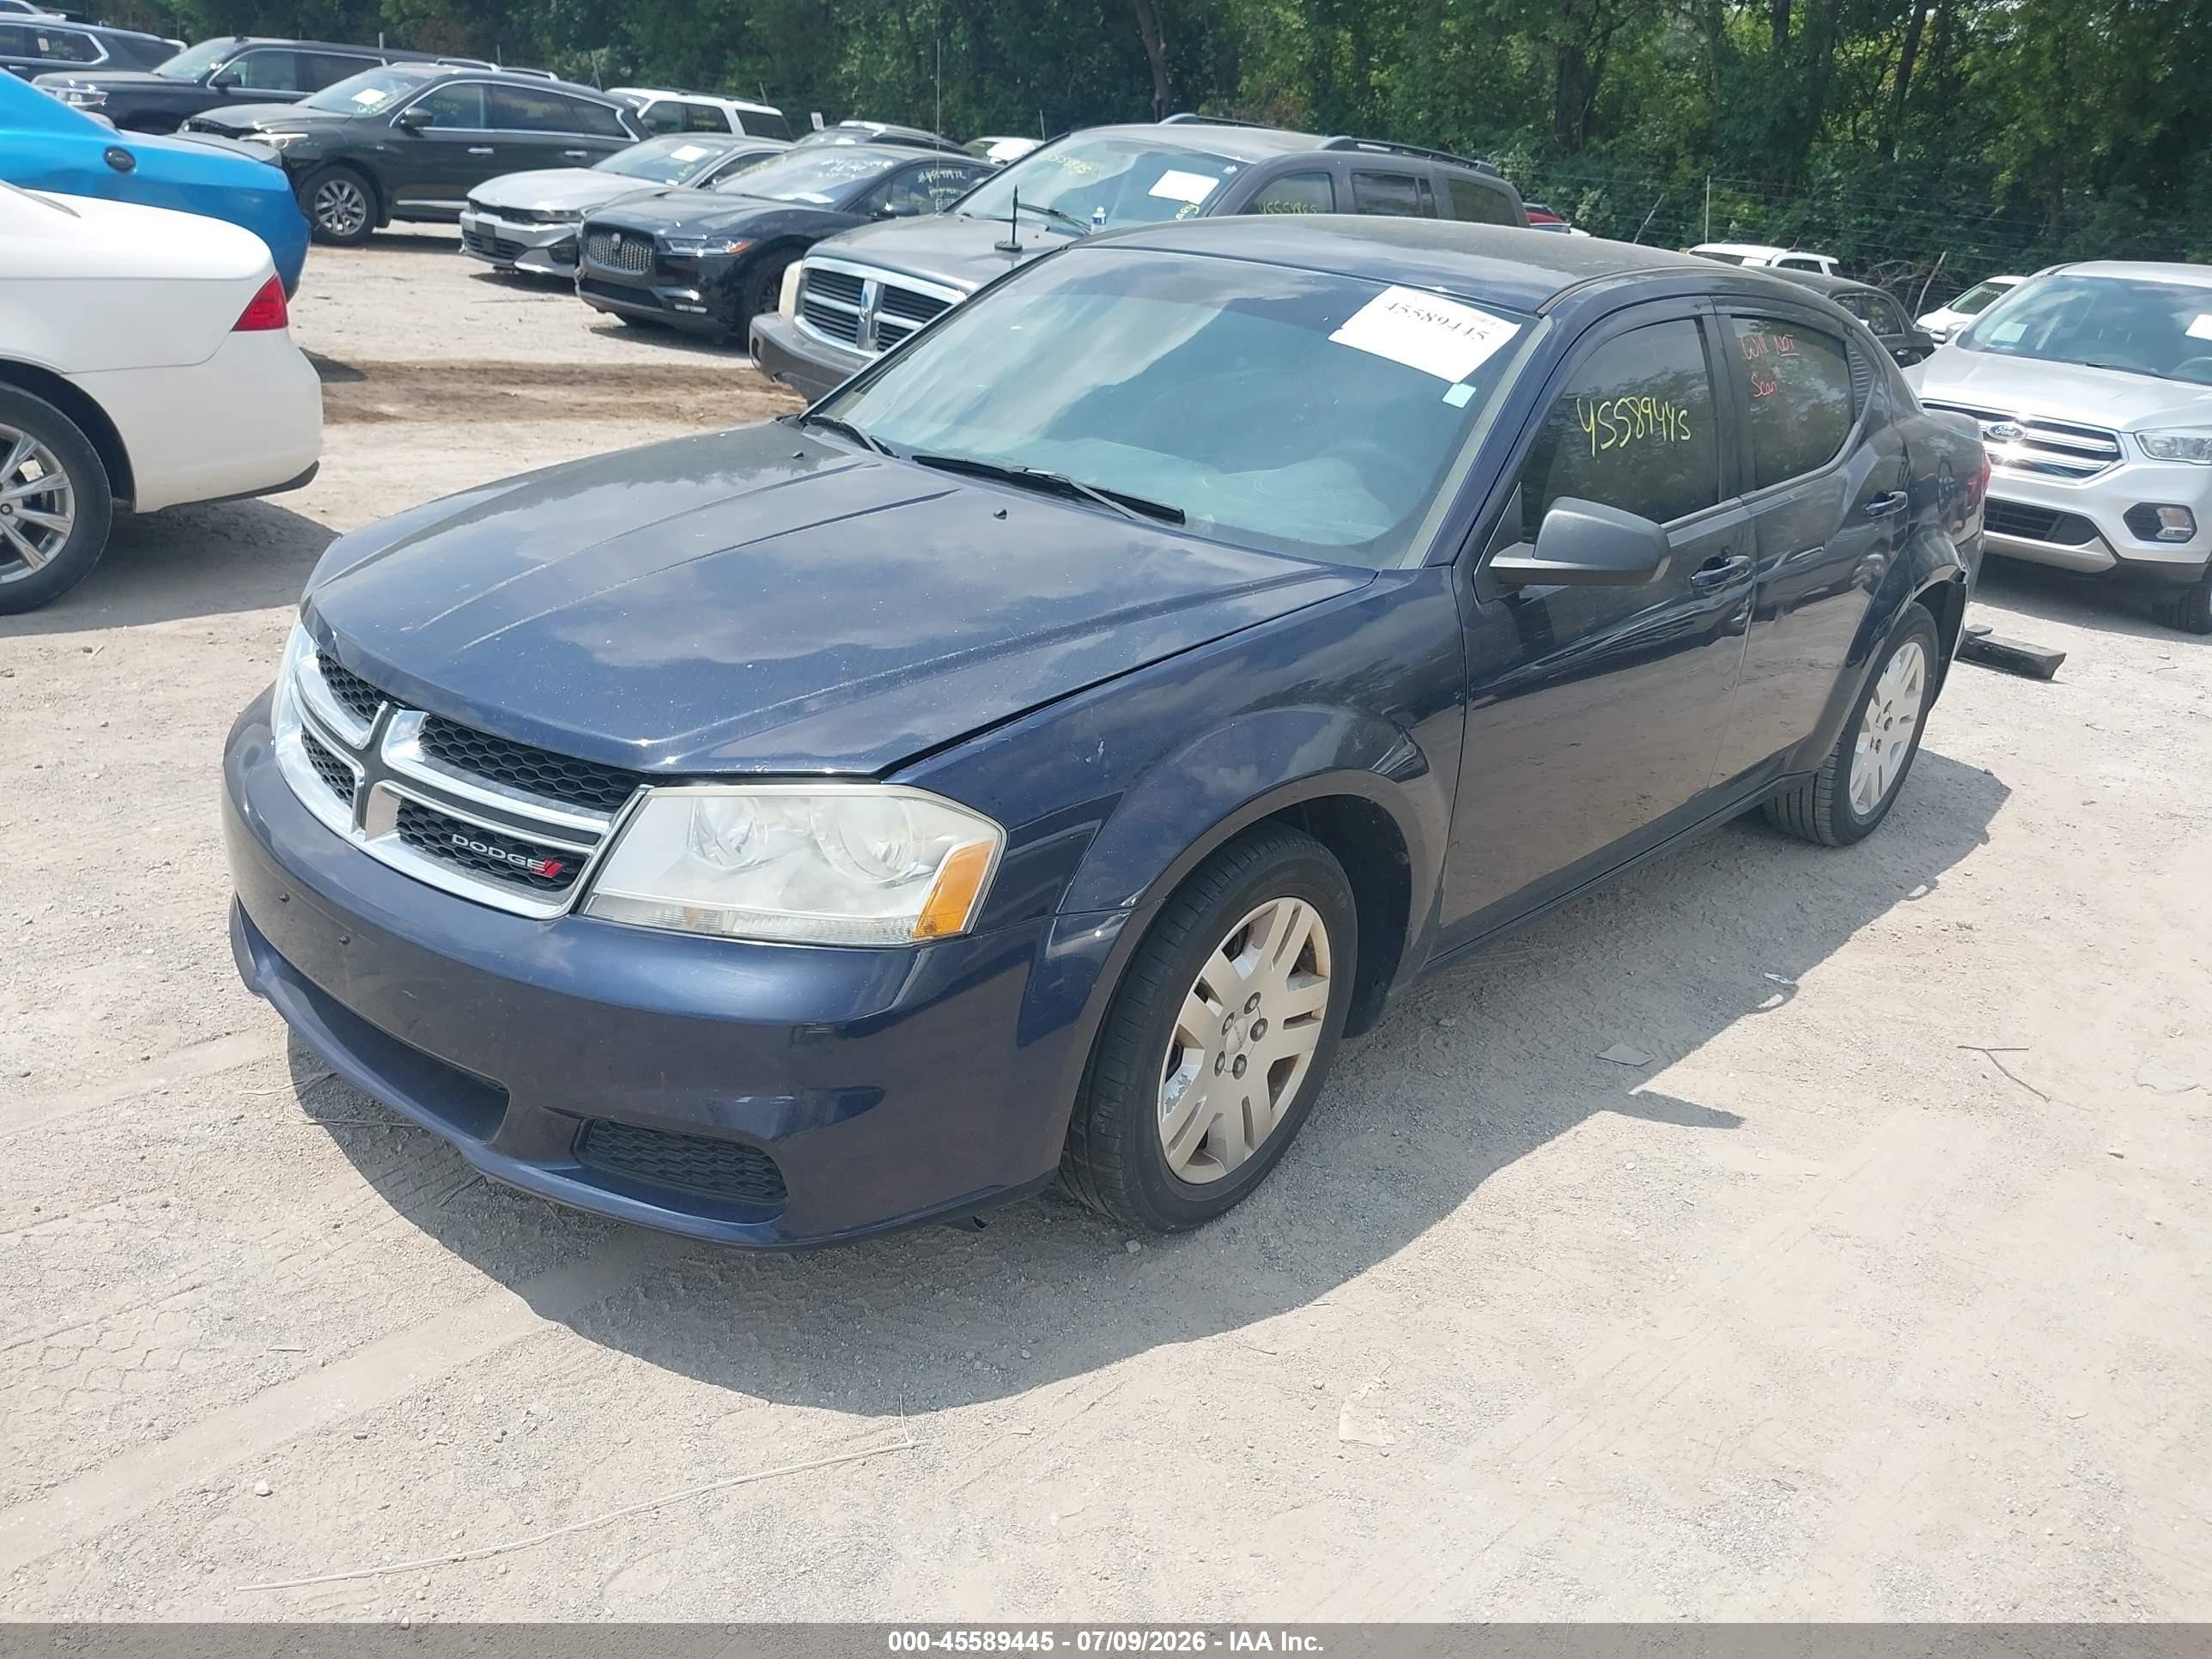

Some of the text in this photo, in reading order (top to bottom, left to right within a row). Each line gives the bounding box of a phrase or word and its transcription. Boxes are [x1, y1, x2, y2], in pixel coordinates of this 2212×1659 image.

[1577, 397, 1692, 458] 45589445
[1995, 425, 2017, 437] Ford
[452, 834, 547, 872] DODGE
